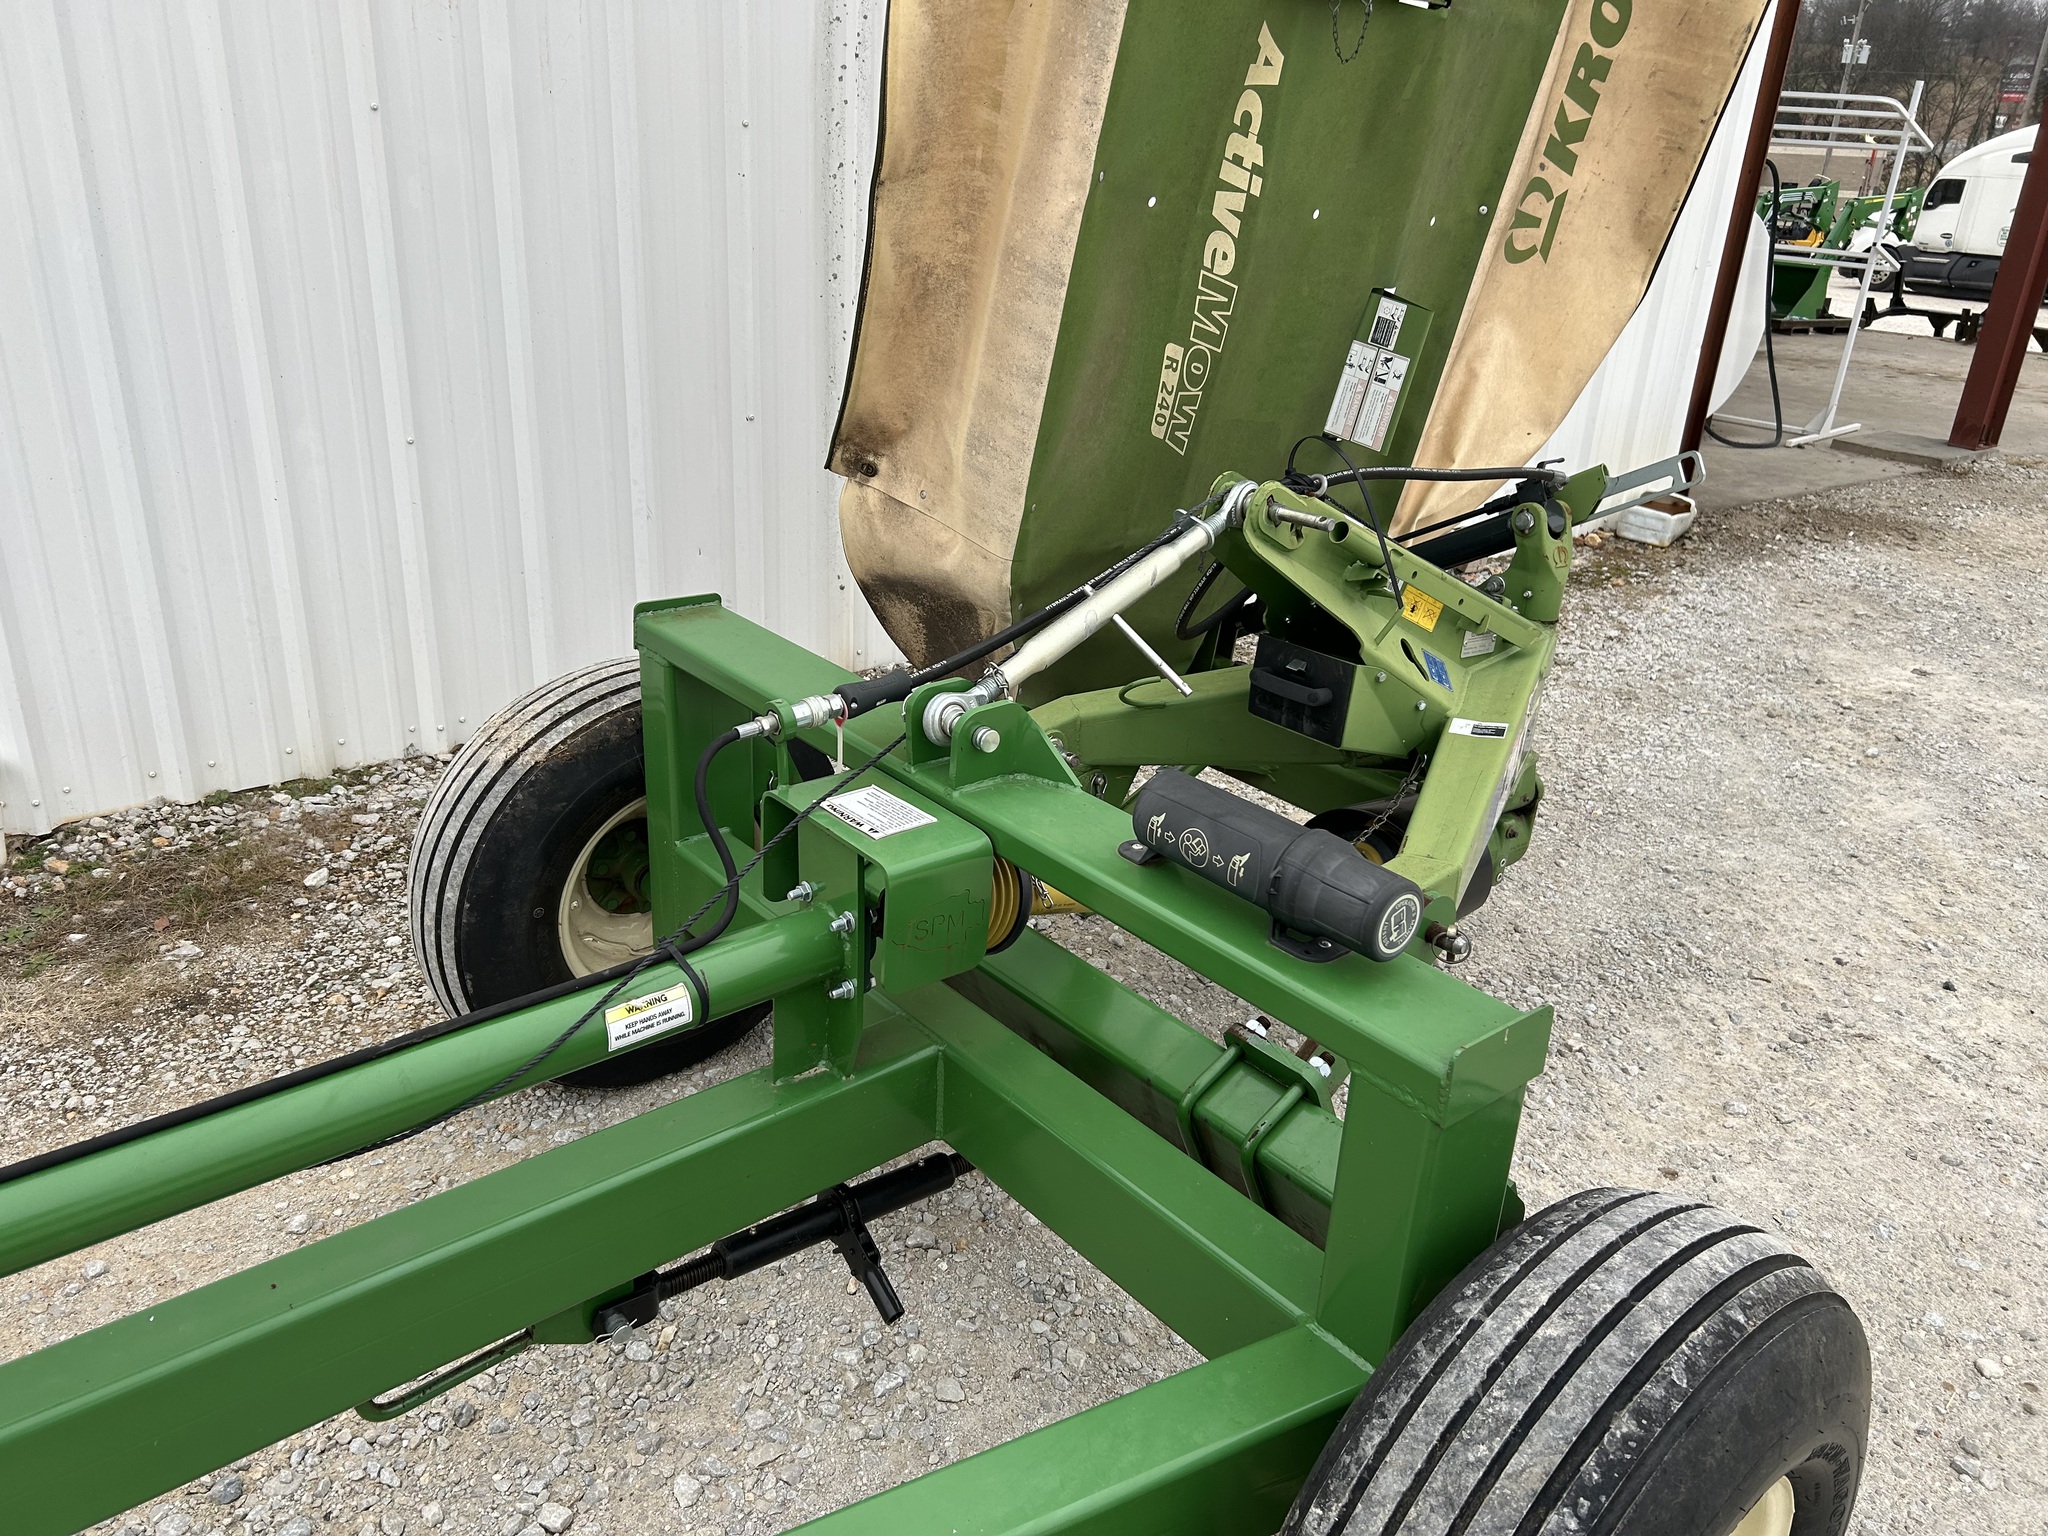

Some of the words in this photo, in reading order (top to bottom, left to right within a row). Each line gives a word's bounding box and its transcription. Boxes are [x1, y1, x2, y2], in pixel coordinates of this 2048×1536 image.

[1543, 0, 1632, 177] KRO
[1166, 355, 1180, 374] R
[1155, 381, 1175, 427] 240
[1346, 394, 1360, 427] DANGER
[1378, 405, 1392, 438] DANGER
[915, 910, 964, 940] SPM
[614, 1032, 631, 1041] WHILE
[632, 1024, 655, 1035] MACHINE
[625, 1020, 639, 1030] KEEP
[639, 1014, 657, 1025] HANDS
[658, 1008, 673, 1018] AWAY
